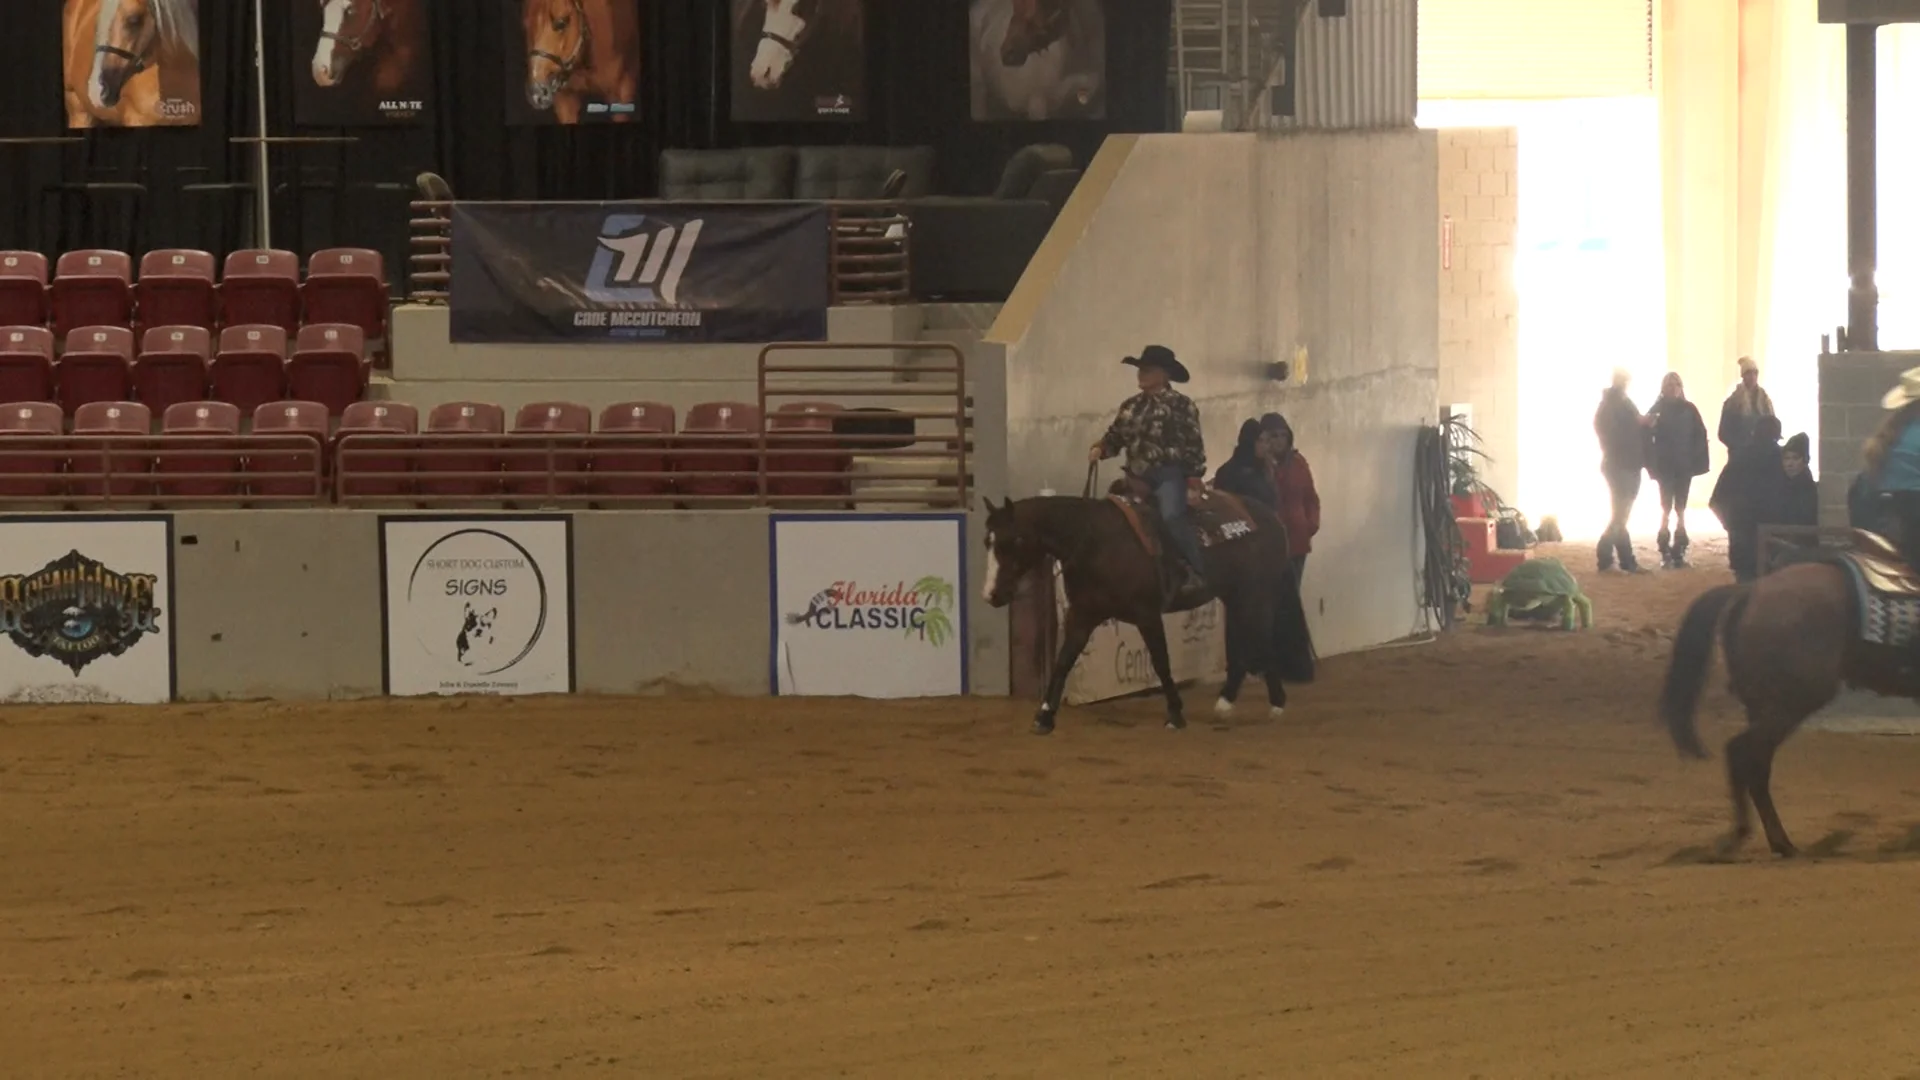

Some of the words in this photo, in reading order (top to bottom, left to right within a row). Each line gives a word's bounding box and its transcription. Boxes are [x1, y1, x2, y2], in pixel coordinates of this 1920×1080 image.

[379, 100, 398, 110] ALL
[427, 559, 458, 569] SHORT
[460, 559, 481, 569] DOG
[483, 559, 524, 569] CUSTOM
[445, 579, 508, 596] SIGNS
[829, 580, 920, 606] Florida
[815, 606, 926, 630] CLASSIC
[52, 631, 101, 652] TATTOO
